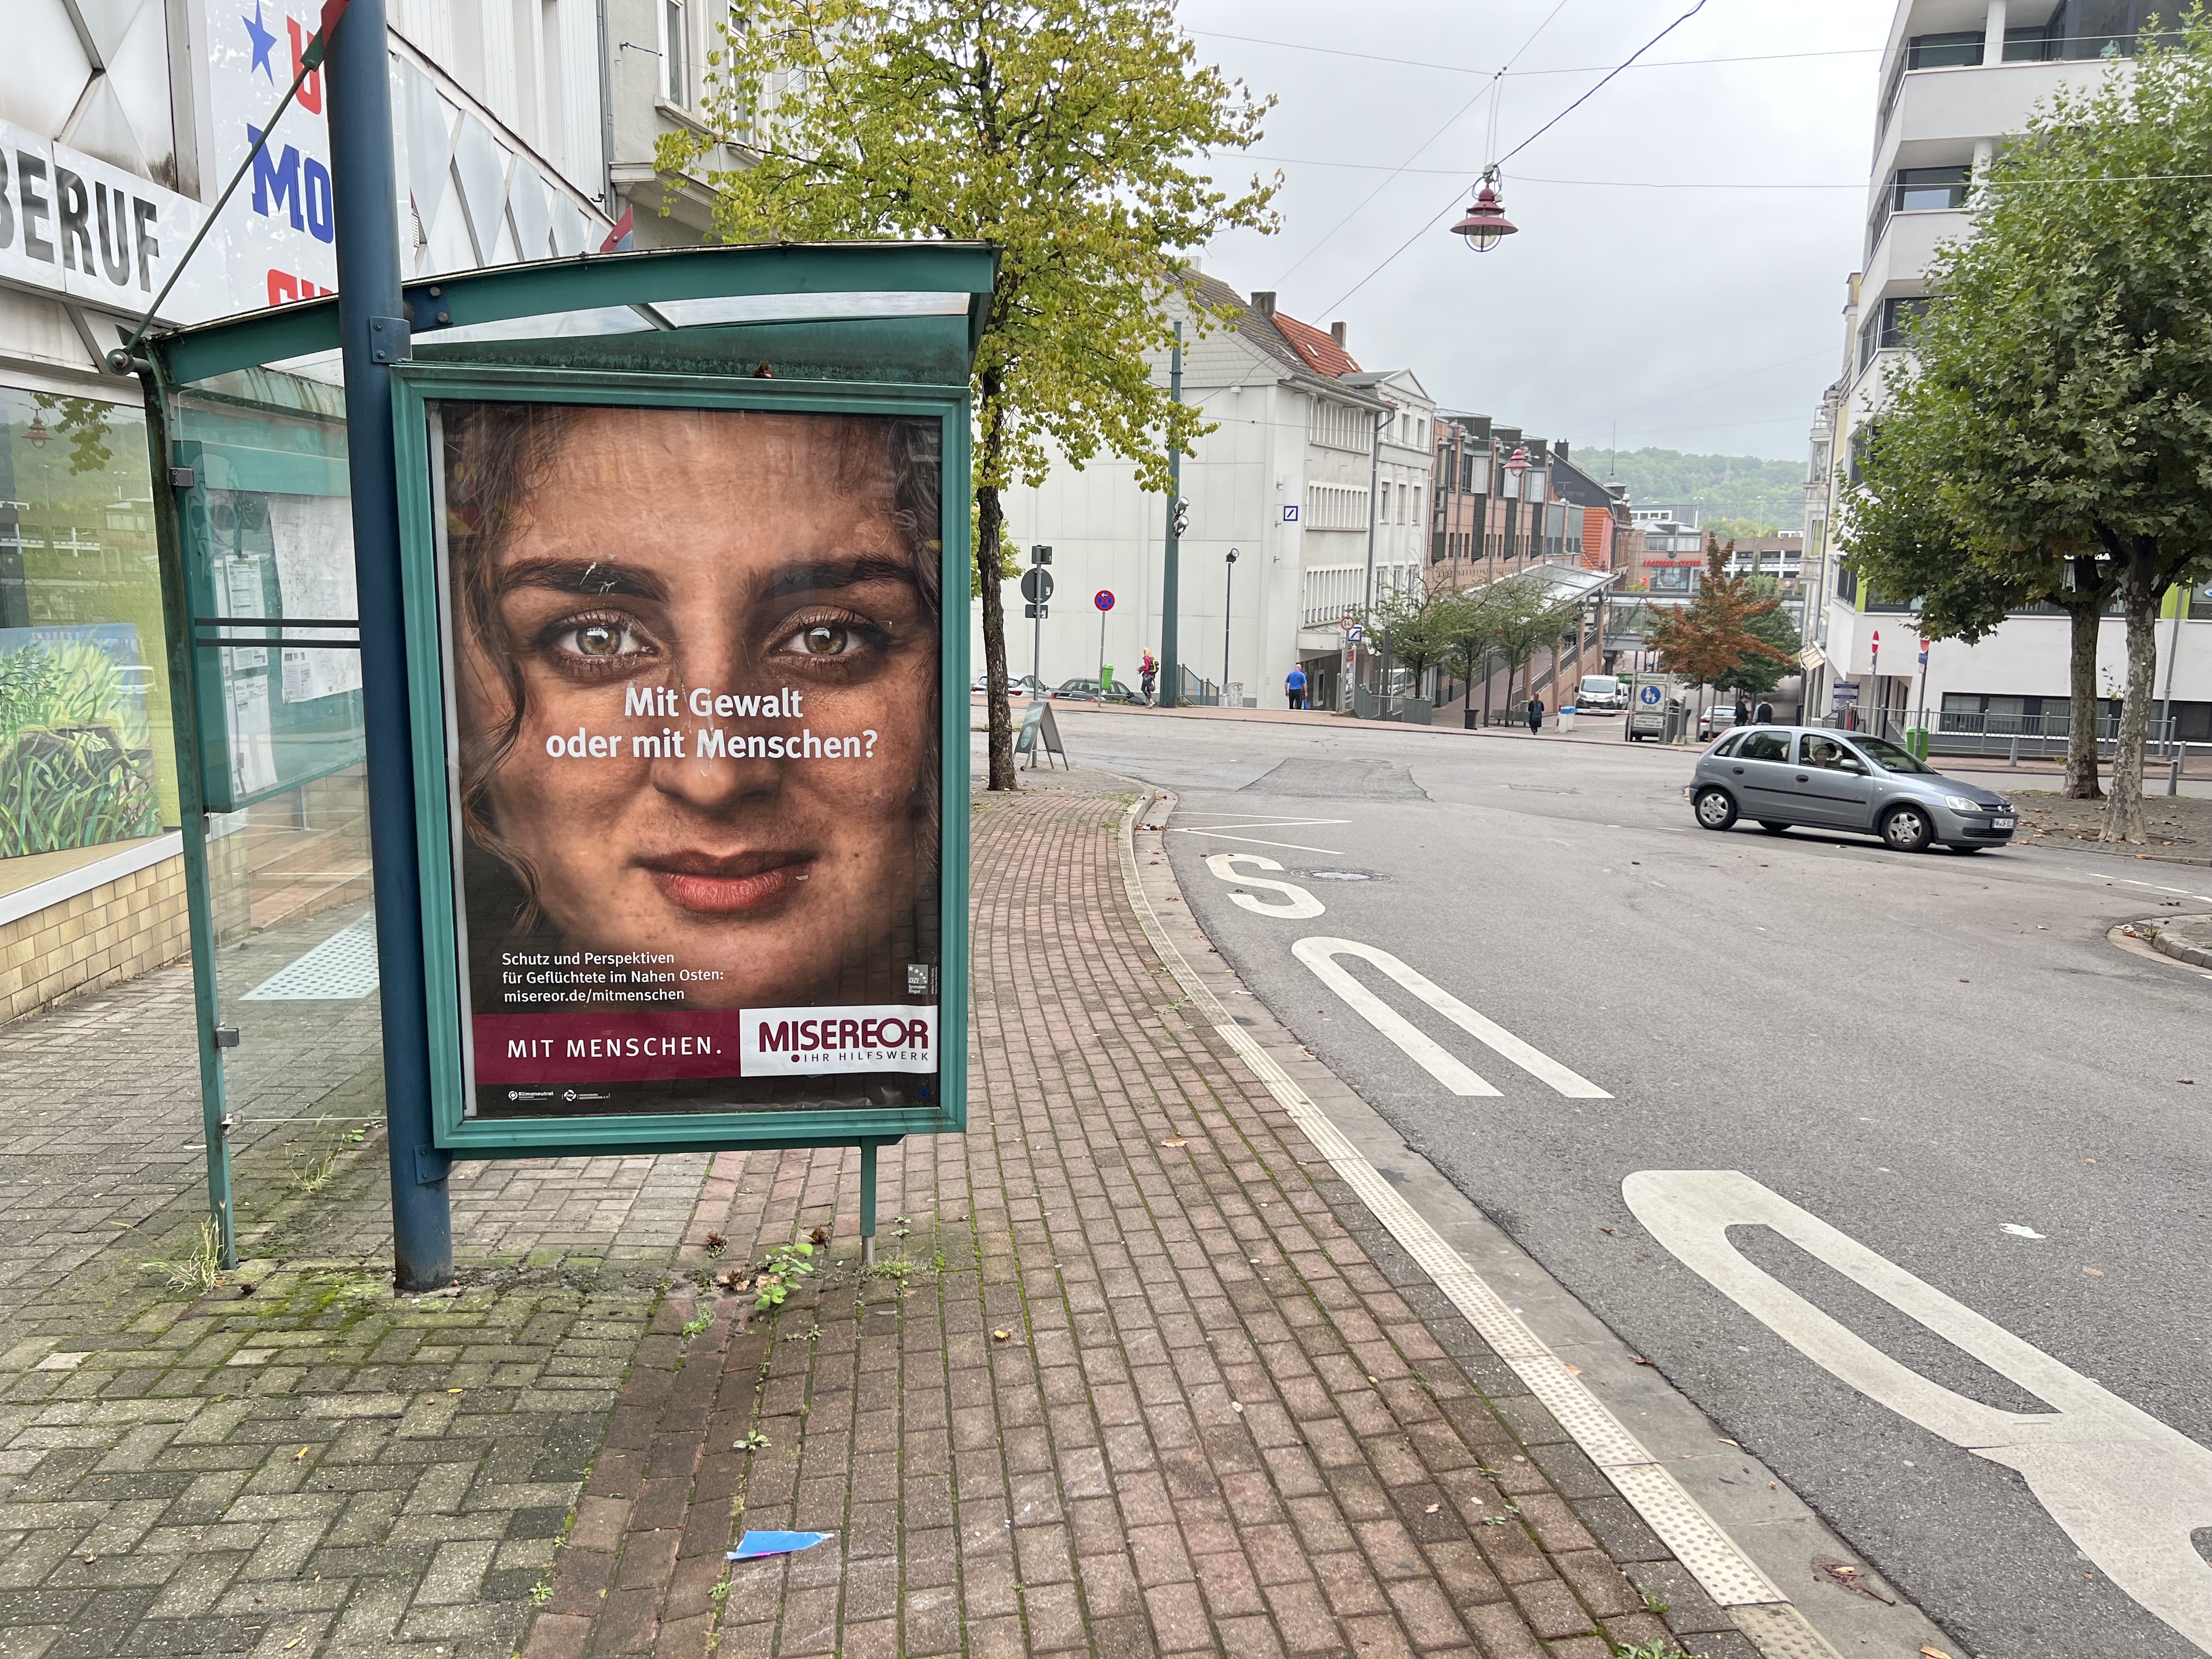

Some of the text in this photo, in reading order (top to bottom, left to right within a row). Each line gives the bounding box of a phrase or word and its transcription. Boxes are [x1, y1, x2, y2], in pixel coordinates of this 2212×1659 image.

[286, 15, 328, 115] U
[624, 686, 803, 718] Mit Gewalt
[546, 727, 878, 759] oder mit Menschen?
[502, 951, 674, 967] Schutz und Perspektiven
[502, 969, 724, 984] für Geflüchtete im Nahen Osten:
[504, 988, 685, 1003] misereor.de/mitmenschen
[759, 1018, 928, 1052] MISEREOR
[507, 1036, 722, 1058] MIT MENSCHEN.
[804, 1051, 929, 1063] IHR HILFSWERK
